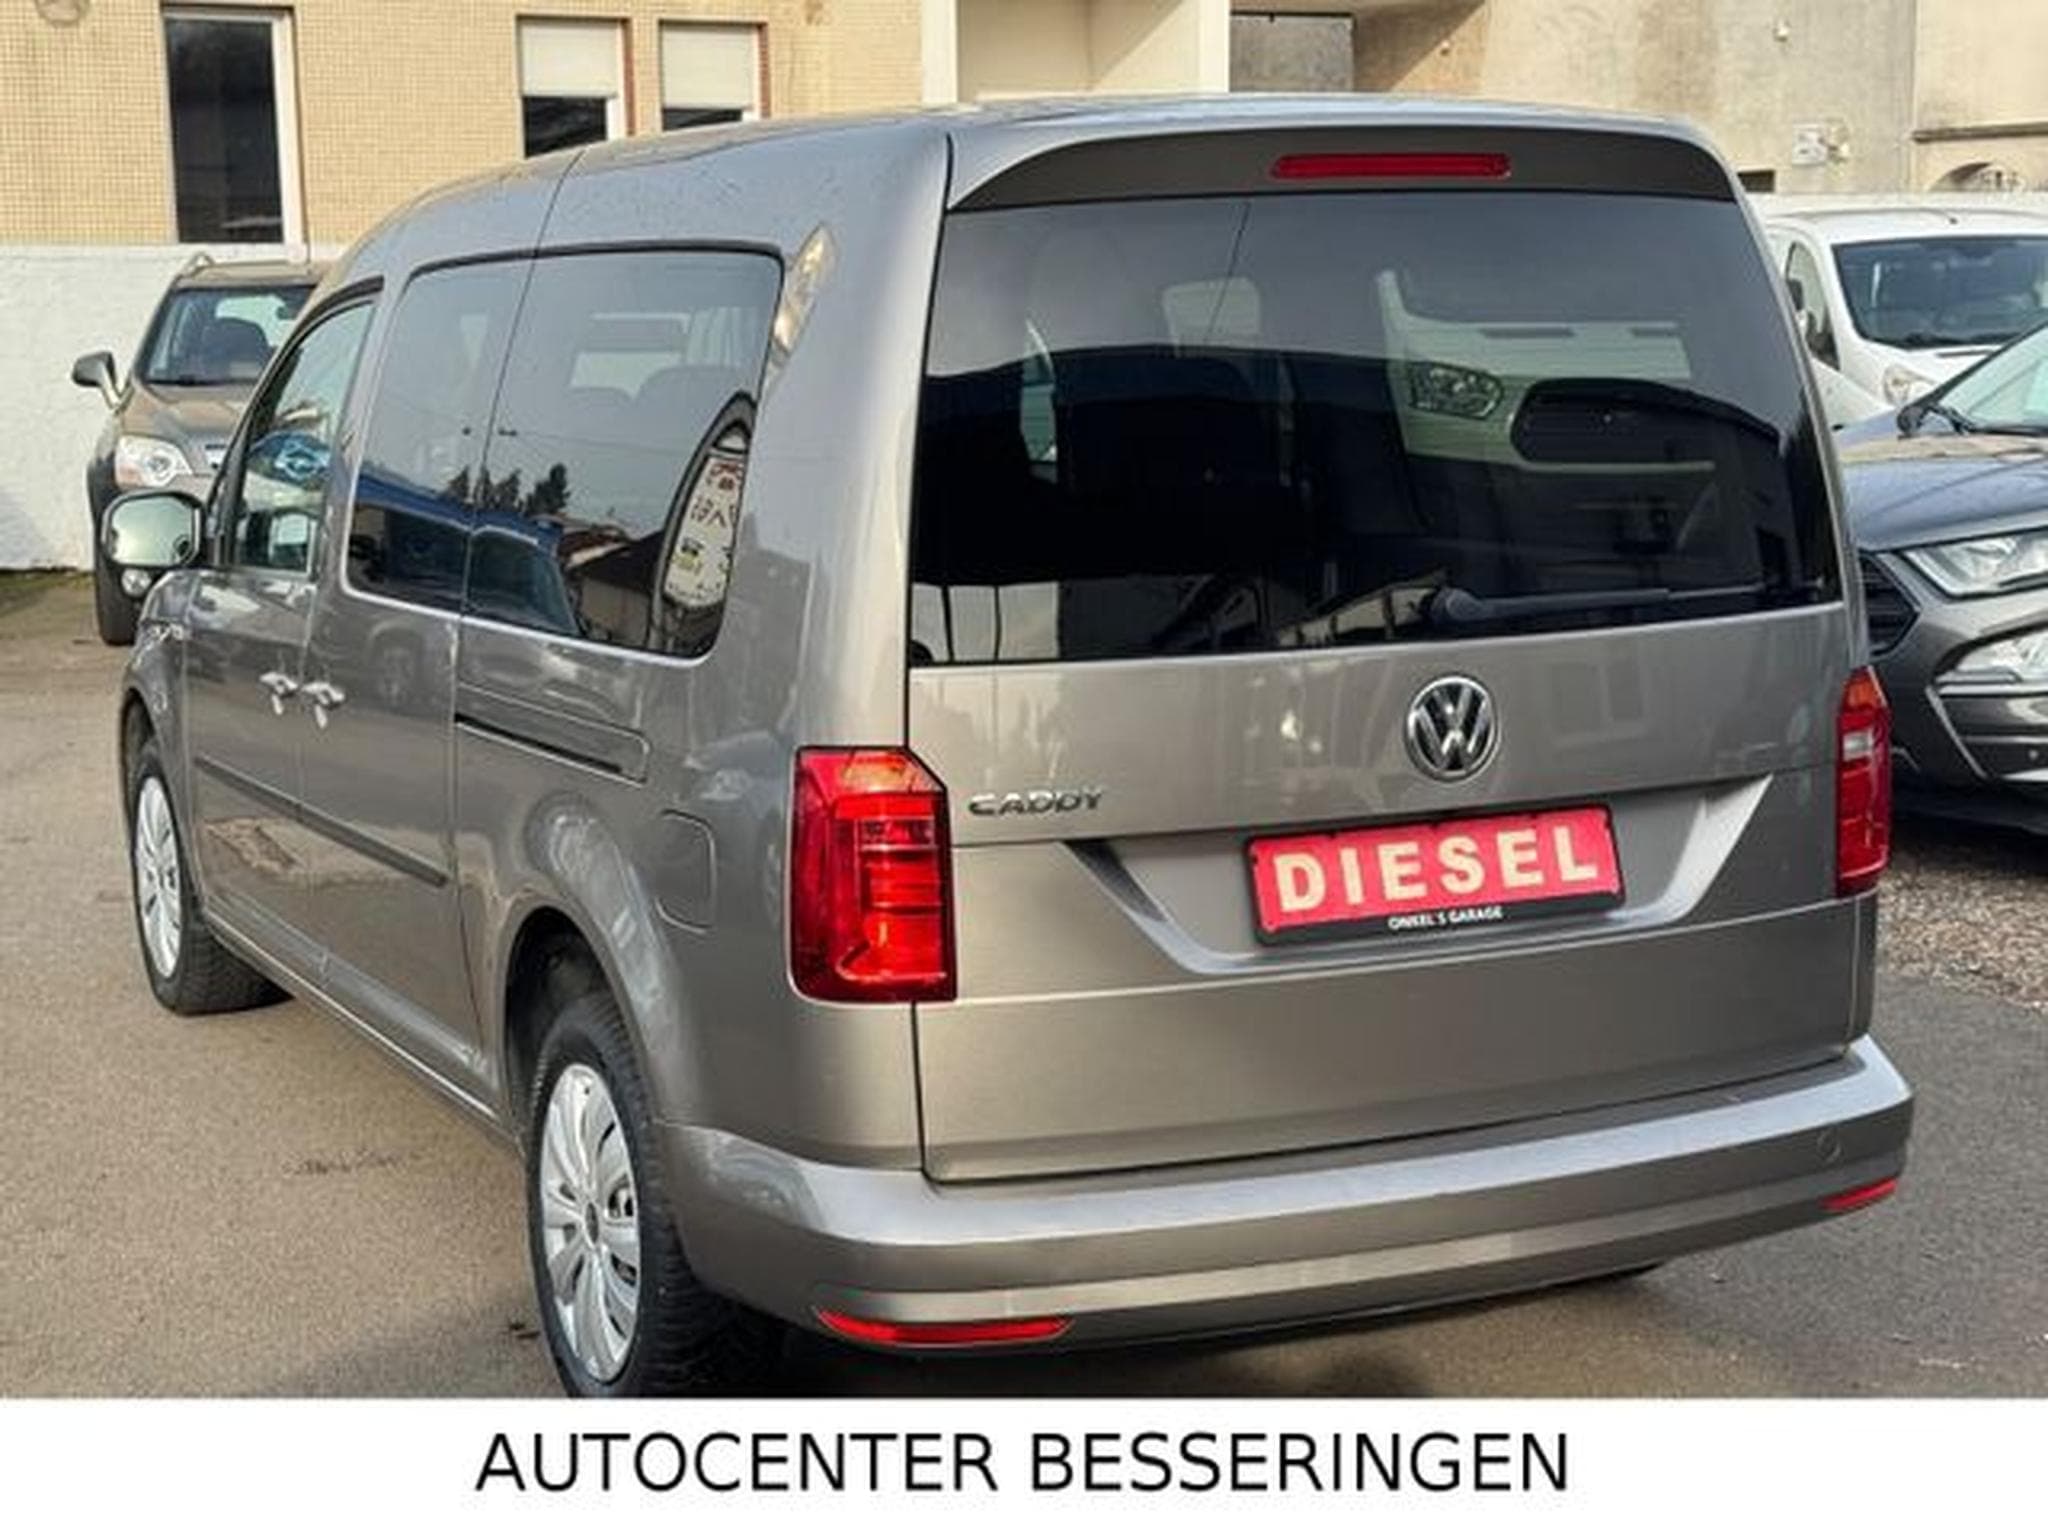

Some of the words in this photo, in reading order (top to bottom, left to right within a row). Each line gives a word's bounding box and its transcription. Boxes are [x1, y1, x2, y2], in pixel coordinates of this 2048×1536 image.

[968, 788, 1101, 816] CADDY
[1273, 825, 1598, 913] DIESEL
[1449, 904, 1503, 923] GARAGE
